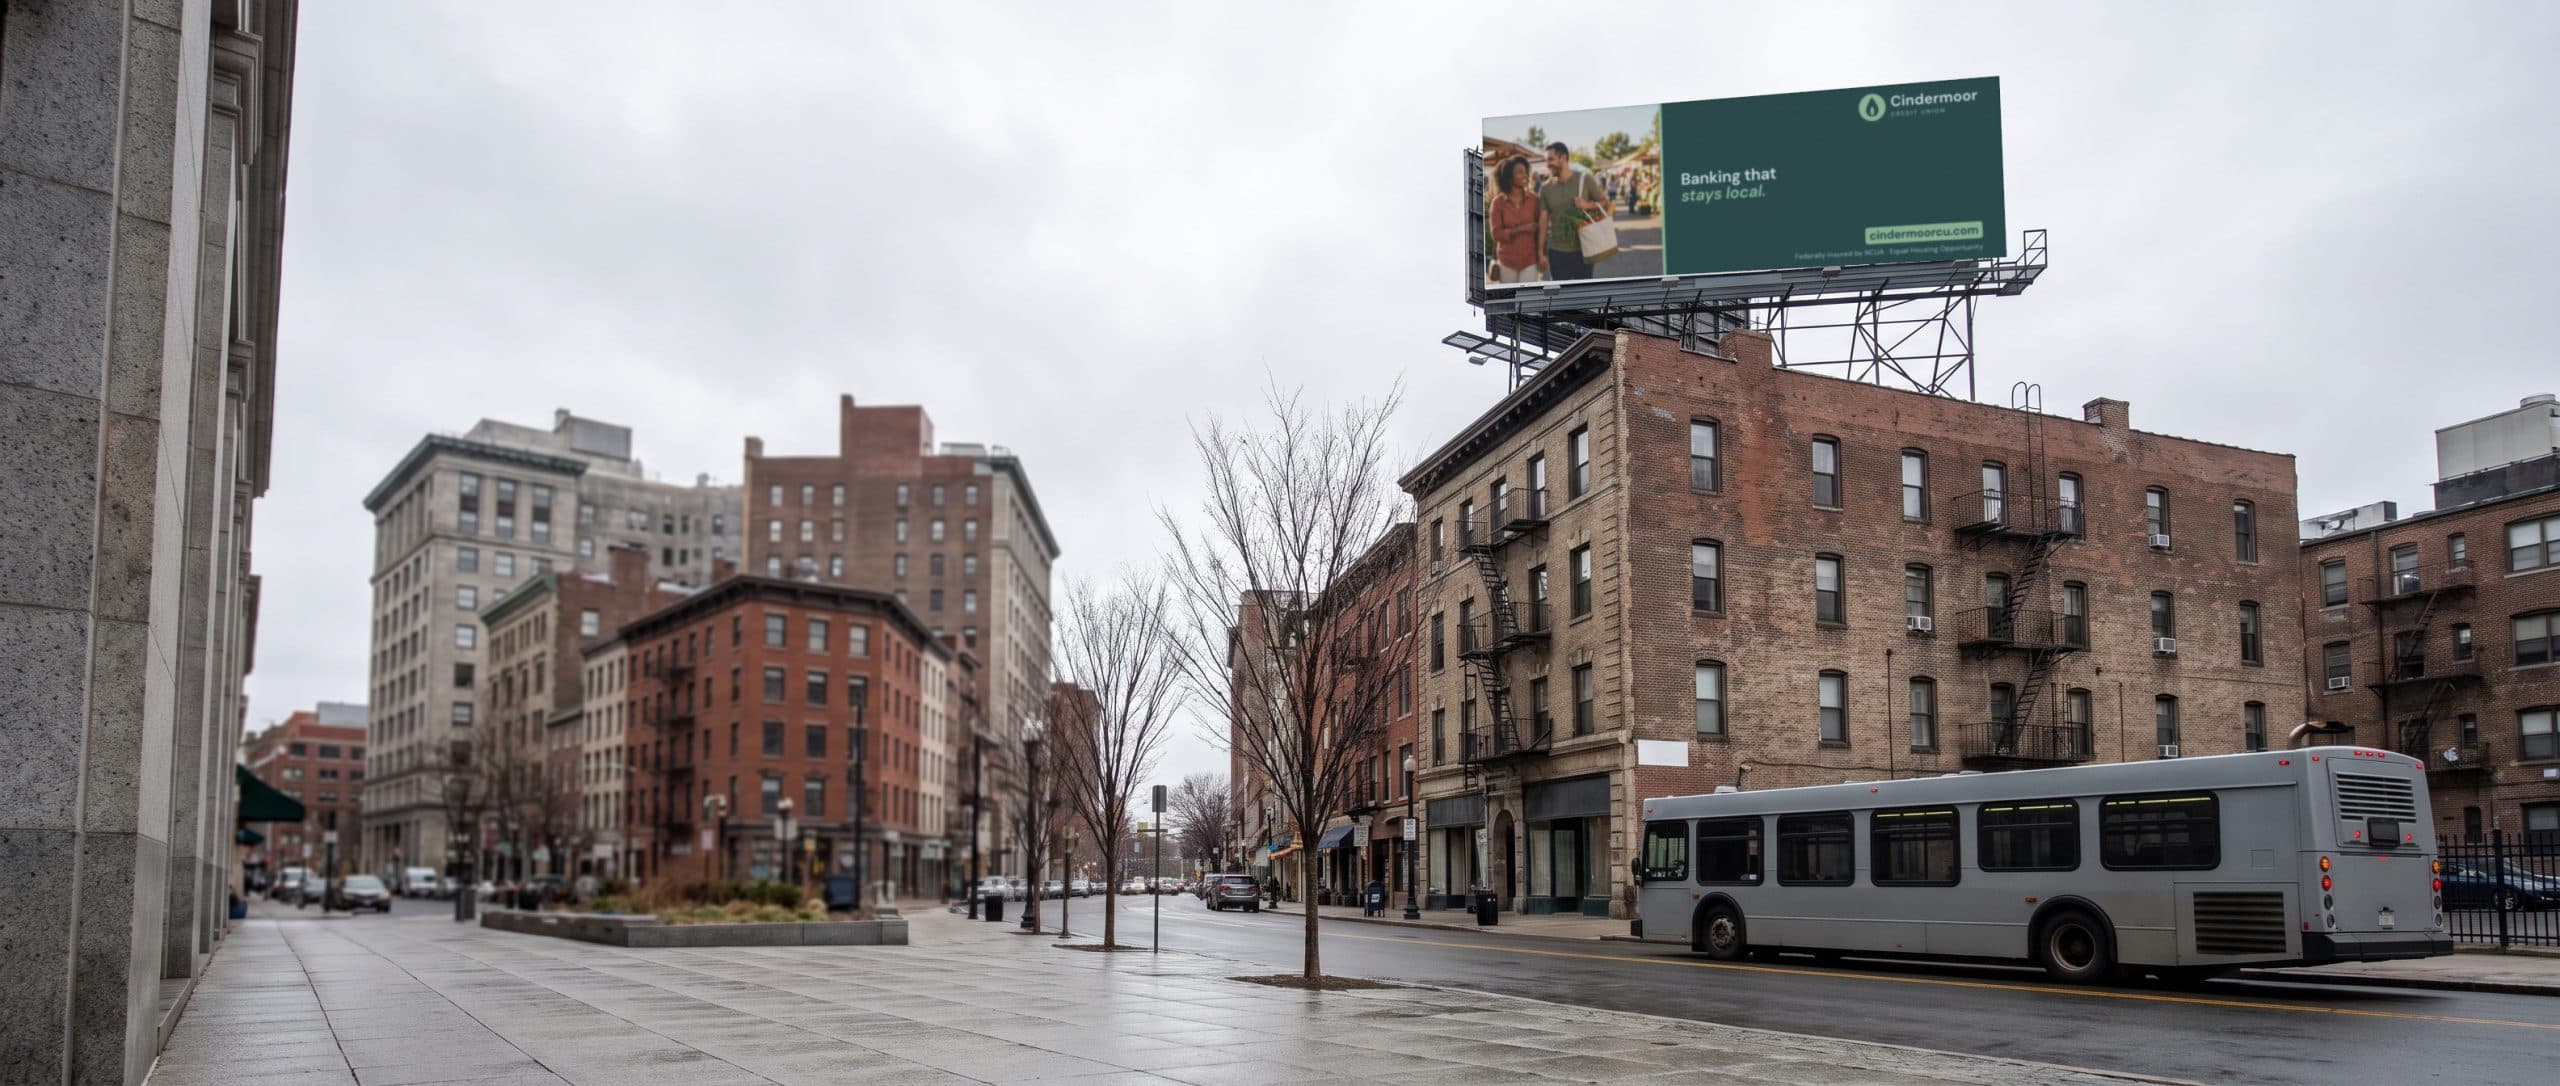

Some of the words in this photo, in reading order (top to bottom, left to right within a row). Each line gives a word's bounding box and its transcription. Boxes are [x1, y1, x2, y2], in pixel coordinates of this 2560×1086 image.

[1890, 91, 1978, 107] Cindermoor
[1681, 169, 1741, 186] Banking
[1744, 168, 1777, 181] that
[1682, 190, 1722, 204] stays
[1725, 183, 1766, 199] local.
[1869, 227, 1980, 241] cindermoorcu.com
